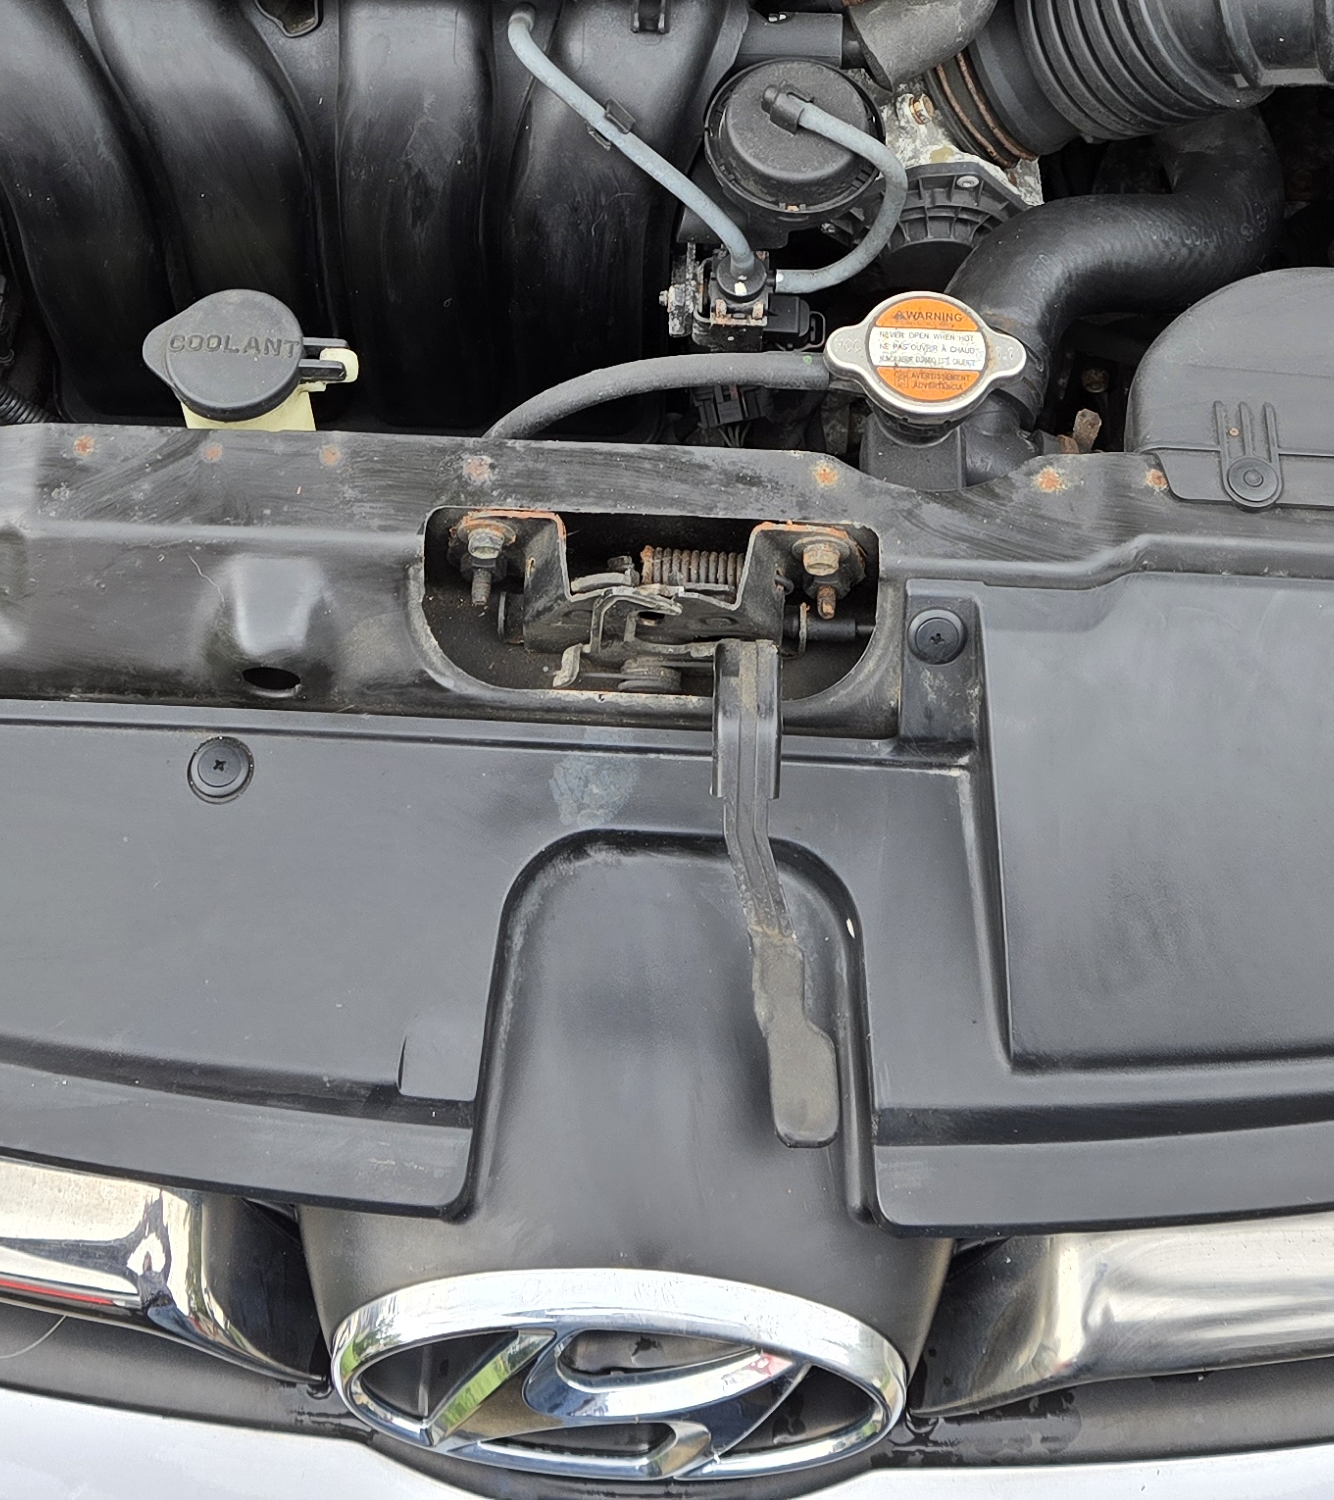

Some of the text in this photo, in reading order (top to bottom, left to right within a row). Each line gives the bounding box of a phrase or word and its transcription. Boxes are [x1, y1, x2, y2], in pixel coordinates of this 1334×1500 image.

[906, 311, 963, 322] WARNING
[960, 334, 974, 342] HOT
[169, 333, 303, 358] COOLANT
[911, 371, 970, 381] AVERTISSEMENT
[912, 381, 963, 390] ADVERTENCIA
